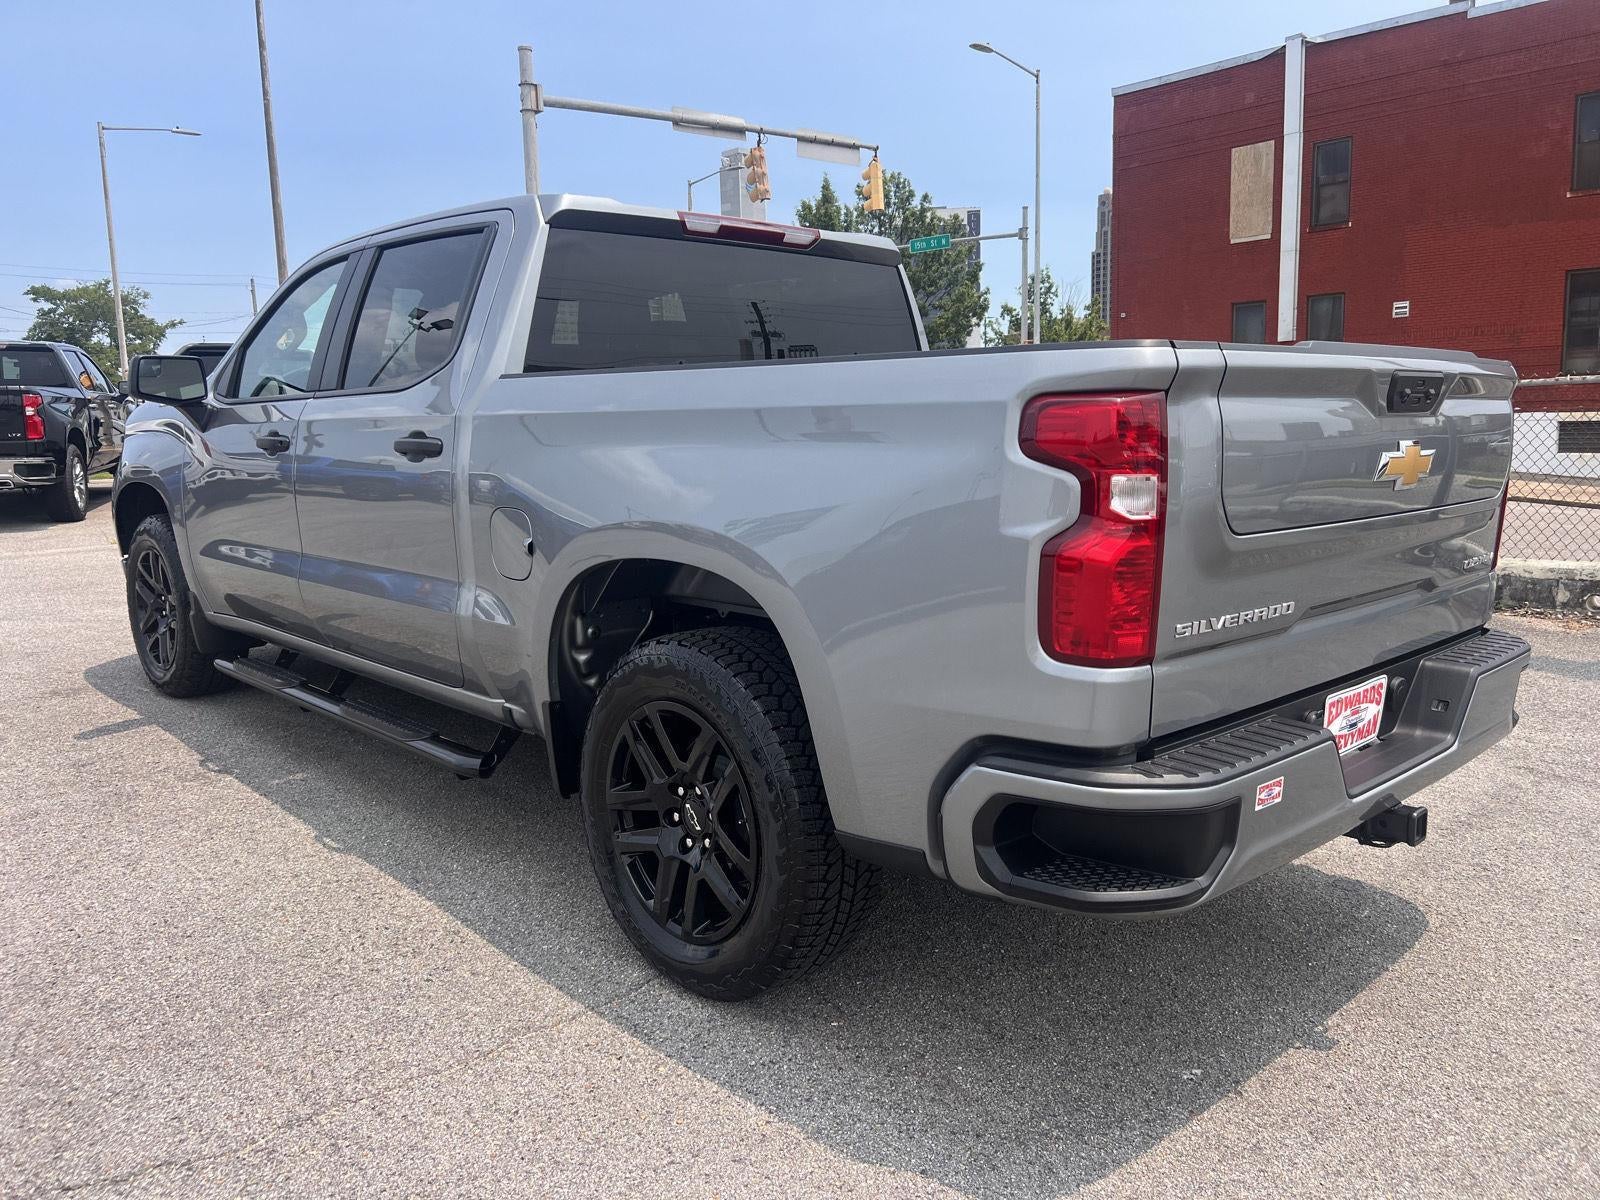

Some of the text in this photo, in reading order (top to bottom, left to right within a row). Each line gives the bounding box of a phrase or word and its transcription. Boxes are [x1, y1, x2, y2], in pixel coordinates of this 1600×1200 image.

[914, 238, 946, 250] 15th St N
[1175, 601, 1296, 639] SILVERADO
[1327, 682, 1384, 728] EDWARDS
[1335, 709, 1381, 751] EVYMAN
